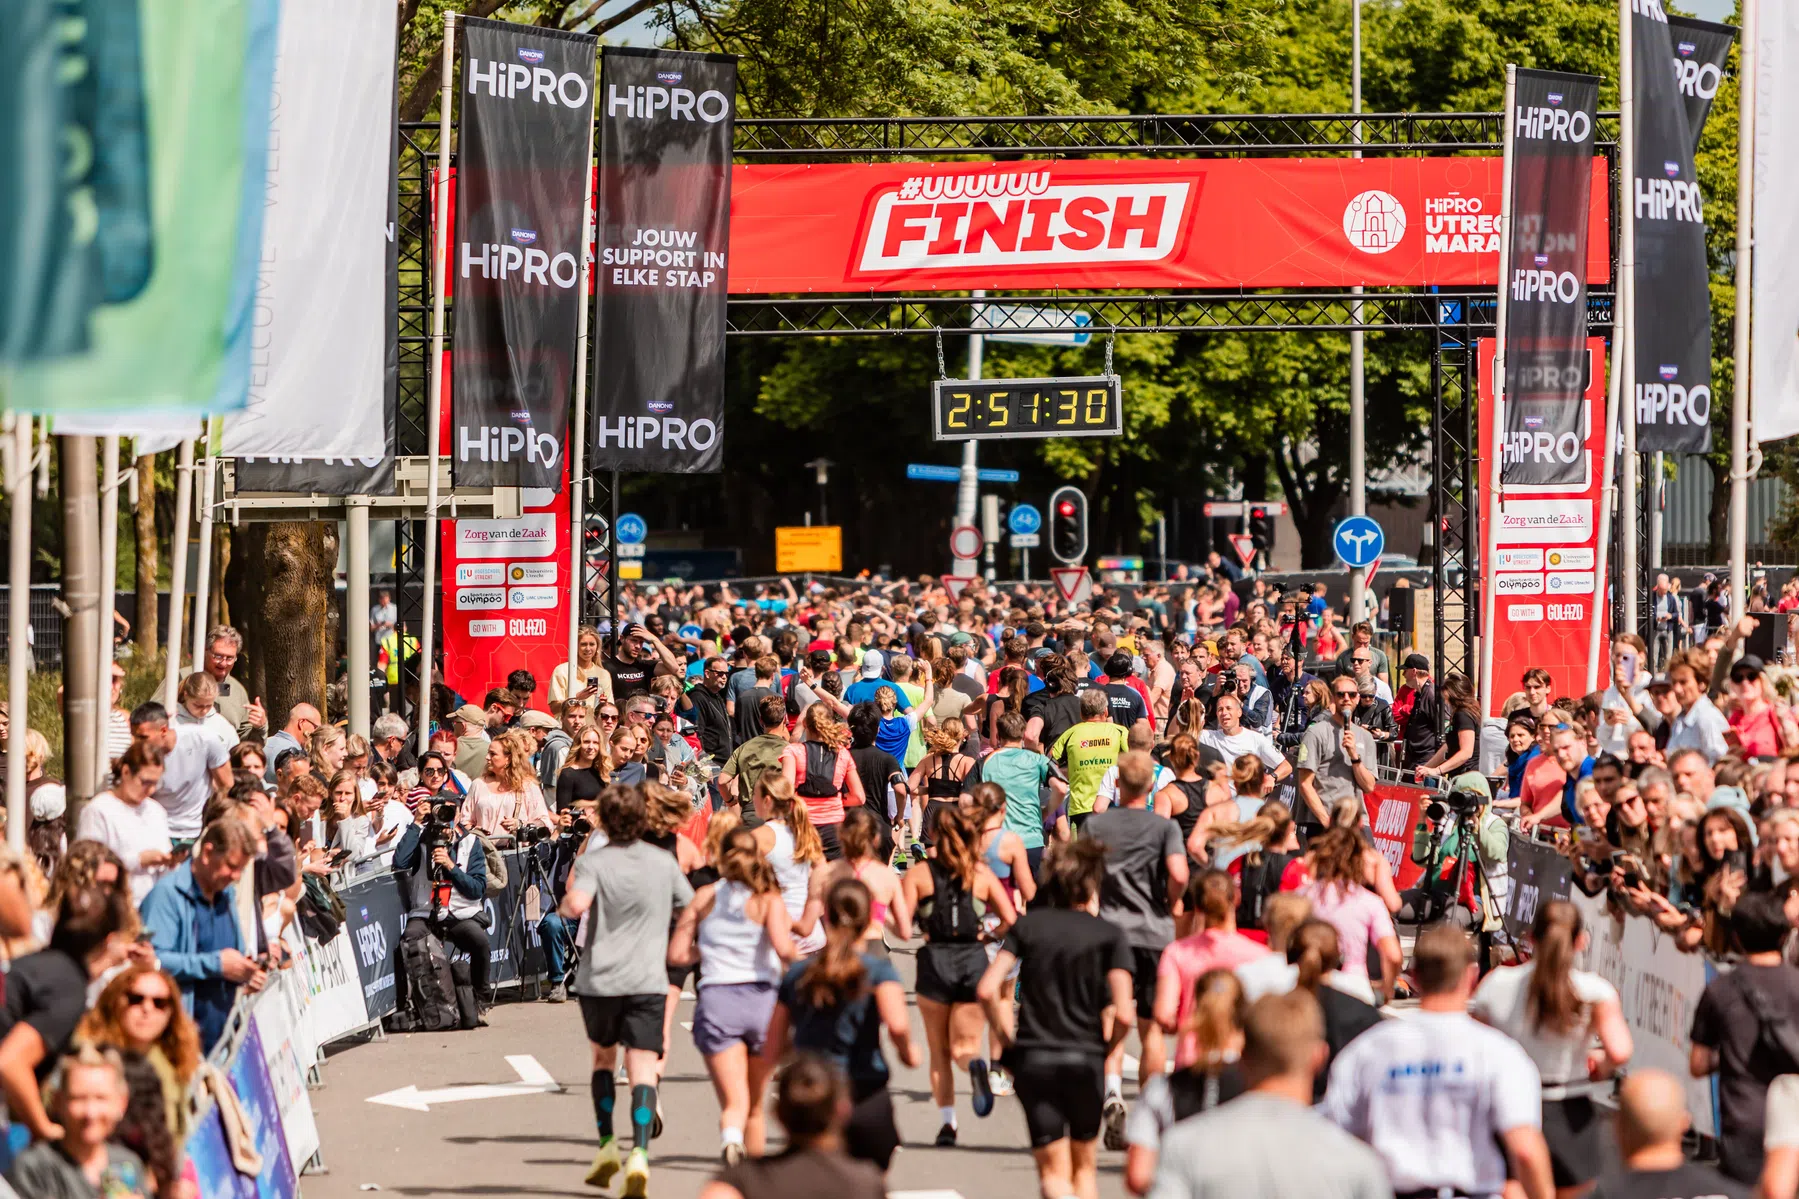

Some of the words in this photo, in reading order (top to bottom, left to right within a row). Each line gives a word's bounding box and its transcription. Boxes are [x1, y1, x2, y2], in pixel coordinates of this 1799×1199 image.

[519, 49, 543, 58] DANONE
[468, 58, 588, 109] HiPRO
[608, 84, 729, 123] HiPRO
[1516, 106, 1591, 143] HiPRO
[897, 172, 1050, 199] #UUUUUU
[1425, 197, 1482, 213] HiPRO
[1635, 178, 1704, 223] HiPRO
[511, 230, 536, 240] DANONE
[881, 195, 1168, 257] FINISH
[632, 229, 697, 248] JOUW
[461, 242, 577, 288] HiPRO
[602, 248, 697, 268] SUPPORT
[703, 252, 725, 269] IN
[613, 268, 659, 286] ELKE
[665, 270, 715, 288] STAP
[1512, 269, 1579, 304] HiPRO
[948, 390, 1107, 428] 2:51:30
[1636, 383, 1711, 427] HiPRO
[599, 416, 716, 451] HiPRO
[1503, 431, 1580, 464] HiPRO
[1503, 515, 1526, 526] Zorg
[1527, 516, 1546, 524] van
[1547, 515, 1559, 524] de
[1559, 514, 1584, 524] Zaak
[464, 529, 488, 540] Zorg
[509, 529, 522, 538] de
[522, 528, 547, 538] Zaak
[1512, 608, 1520, 617] GO
[1520, 608, 1535, 617] WITH
[1547, 604, 1583, 621] GOLAZO
[473, 623, 480, 632] GO
[481, 623, 497, 632] WITH
[509, 619, 546, 636] GOLAZO
[1088, 738, 1110, 748] BOVAG
[1080, 758, 1112, 767] BOVEMIJ
